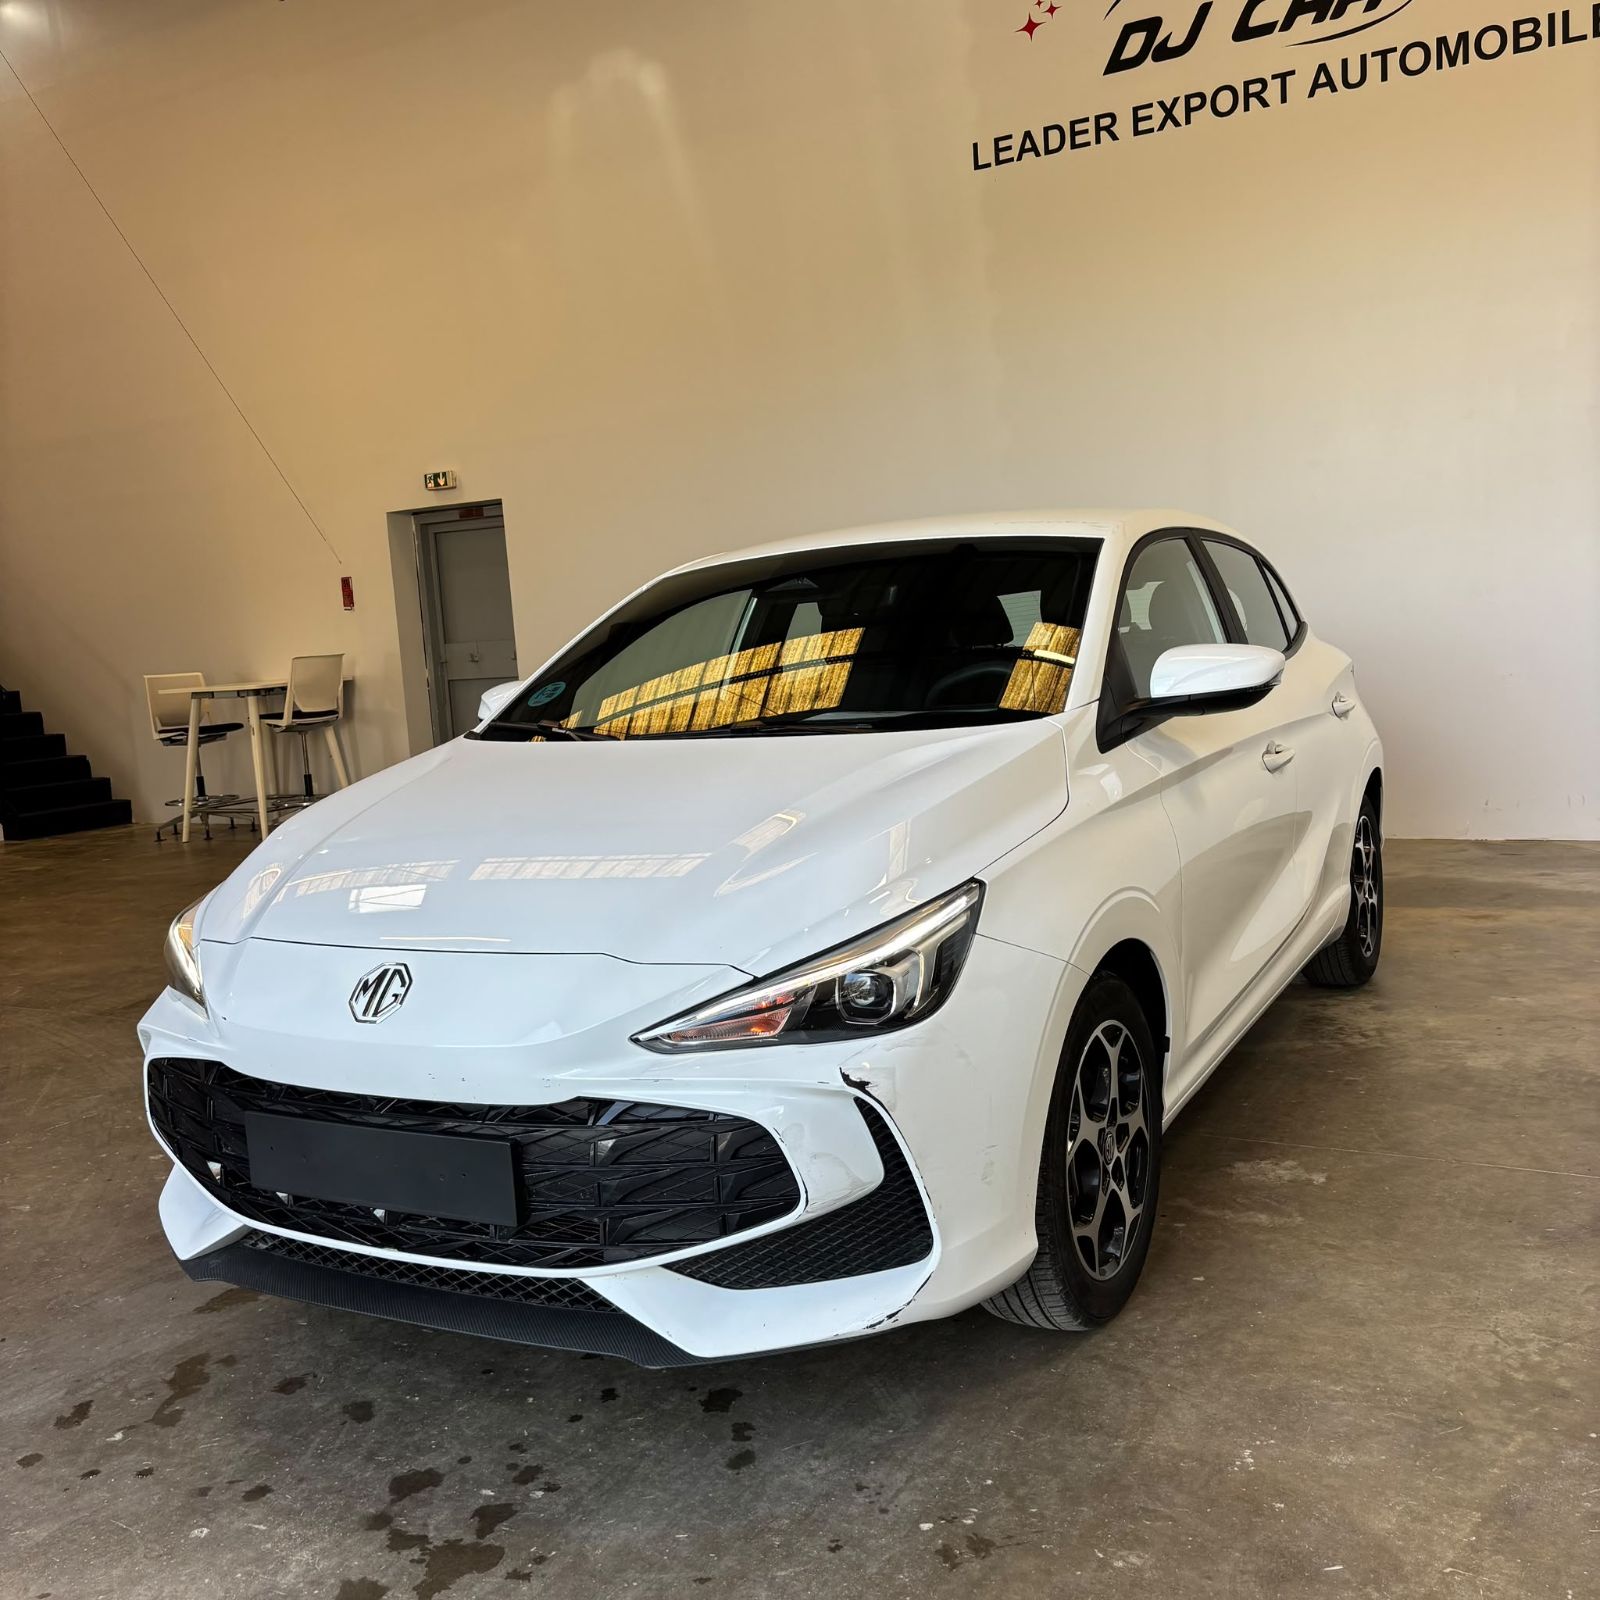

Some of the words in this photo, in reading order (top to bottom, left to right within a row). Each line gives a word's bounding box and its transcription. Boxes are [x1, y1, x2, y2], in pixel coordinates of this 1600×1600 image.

[1102, 1, 1213, 76] DJ
[972, 111, 1120, 171] LEADER
[1131, 69, 1296, 137] EXPORT
[353, 967, 408, 1018] MG
